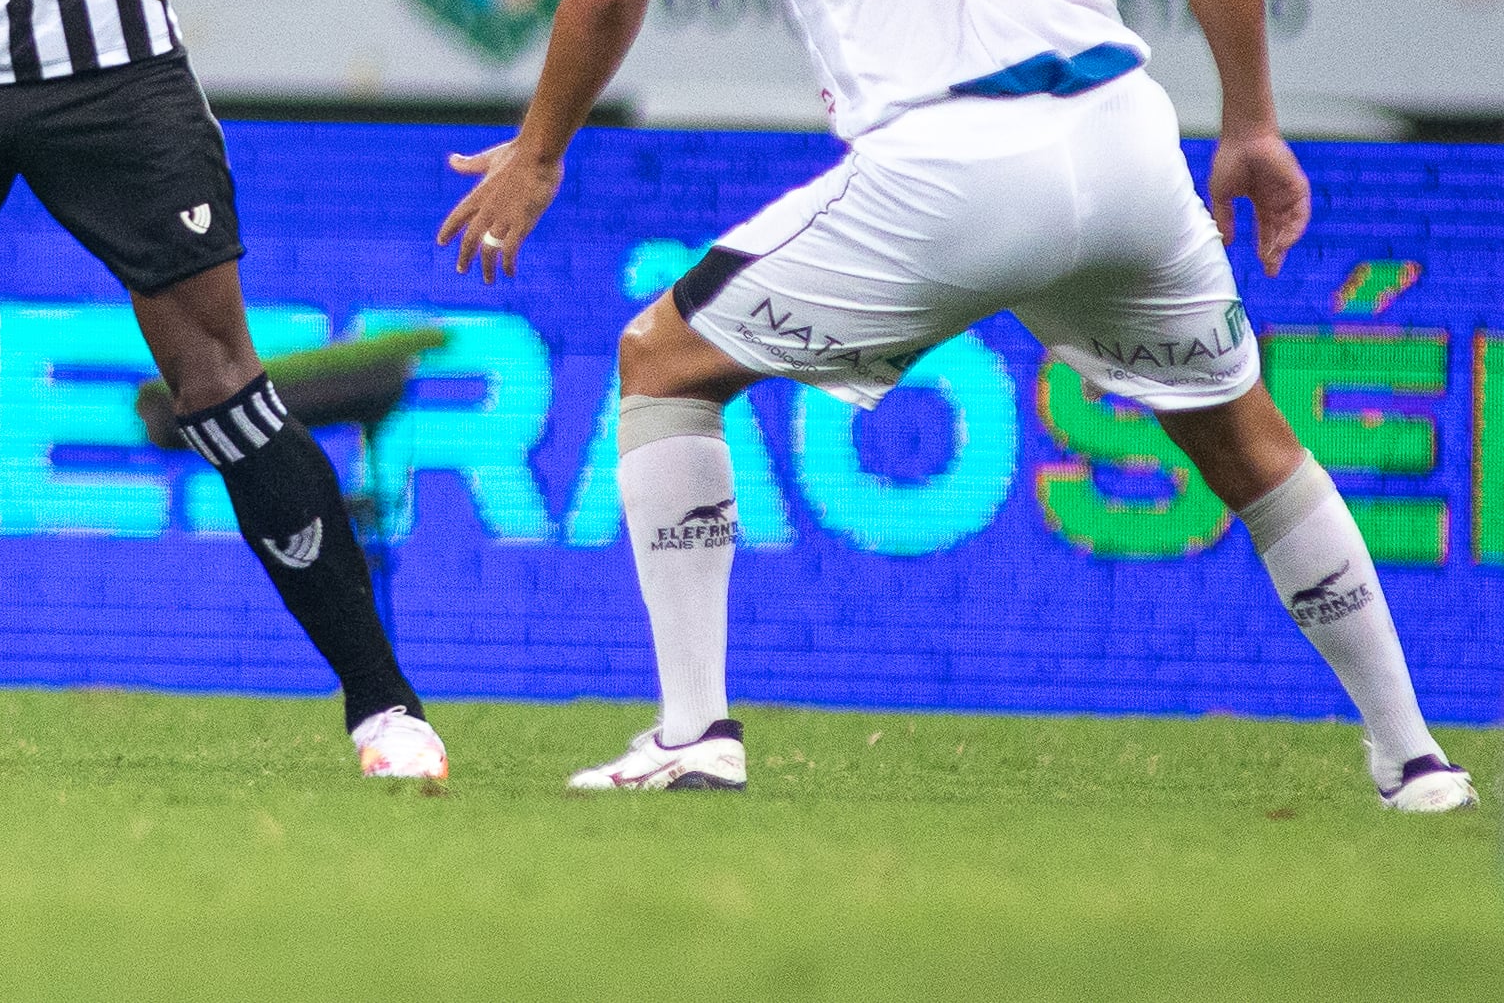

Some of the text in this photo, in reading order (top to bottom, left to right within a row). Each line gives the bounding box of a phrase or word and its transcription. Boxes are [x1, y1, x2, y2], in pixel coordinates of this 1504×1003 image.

[1090, 328, 1233, 368] NATAL
[1036, 260, 1504, 566] SÉ
[650, 539, 694, 551] MAIS
[657, 521, 737, 541] ELEFANT
